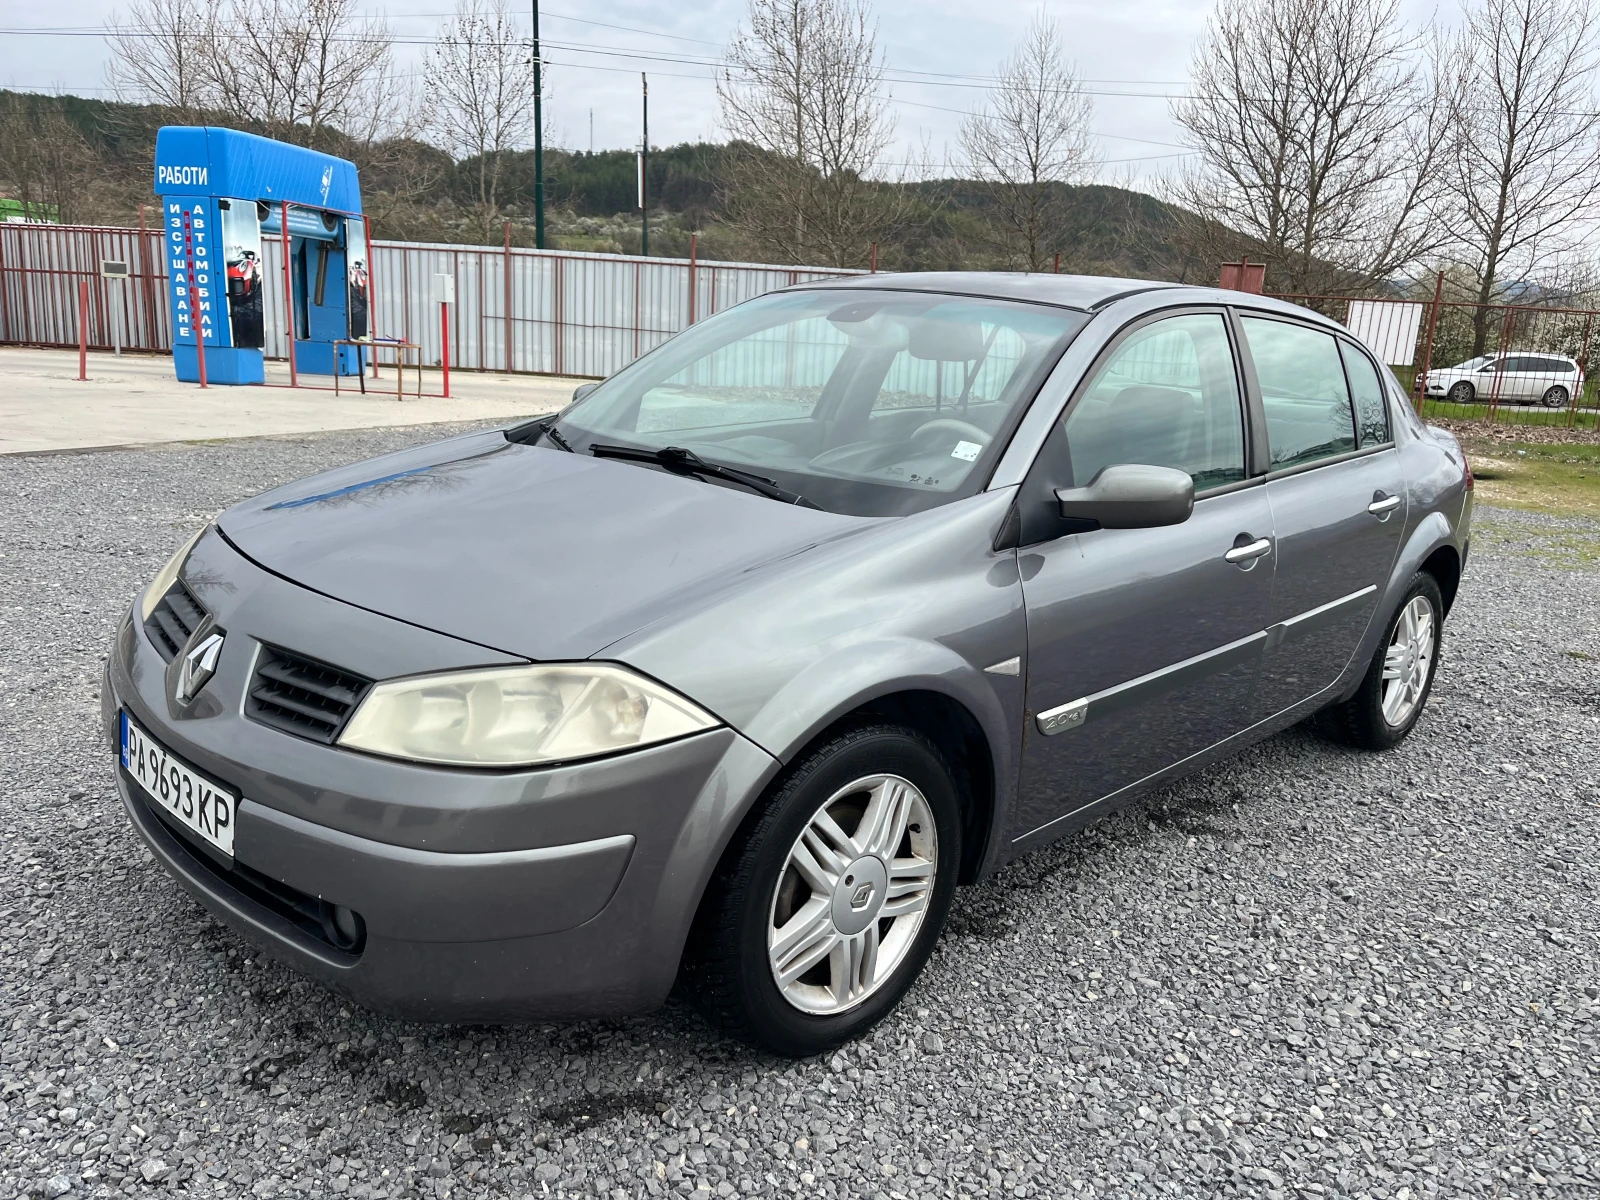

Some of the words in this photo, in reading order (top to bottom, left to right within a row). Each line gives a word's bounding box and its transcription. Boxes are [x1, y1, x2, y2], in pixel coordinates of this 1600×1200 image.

[159, 166, 208, 186] РАБОТИ
[170, 203, 190, 337] ИЗСУШАВАНЕ
[193, 204, 213, 338] АВТОМОБИЛИ
